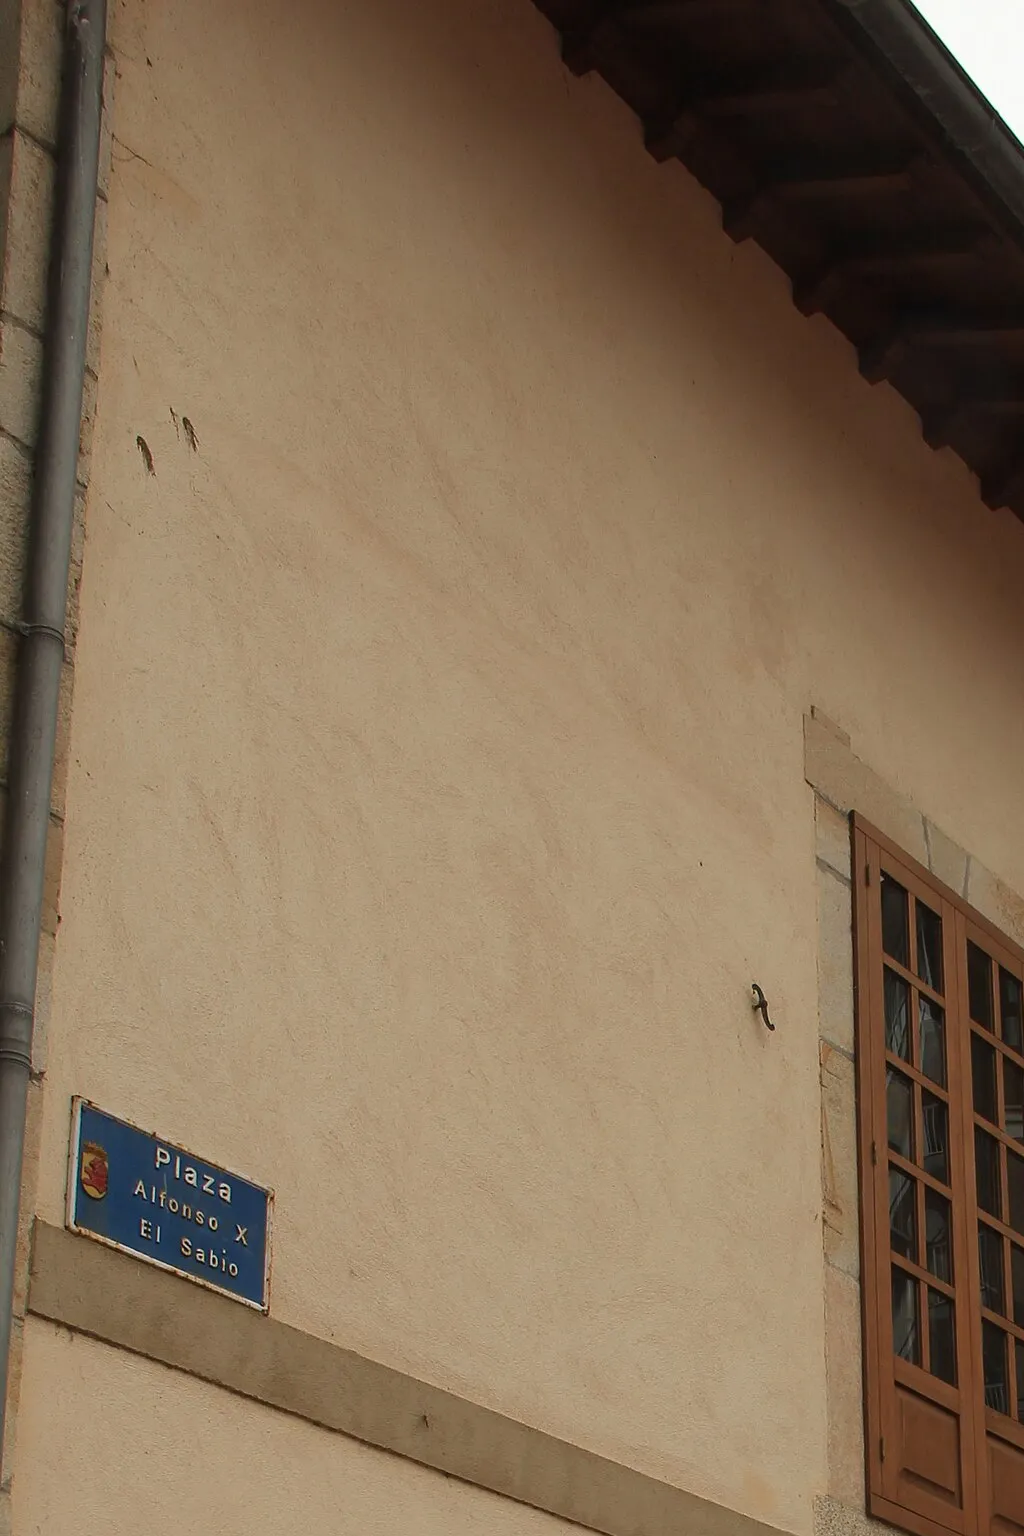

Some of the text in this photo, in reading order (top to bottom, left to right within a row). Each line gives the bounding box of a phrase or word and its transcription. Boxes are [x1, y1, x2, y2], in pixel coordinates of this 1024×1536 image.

[155, 1147, 233, 1204] Plaza
[134, 1179, 249, 1246] Alfonso X
[140, 1217, 239, 1277] El Sabio
